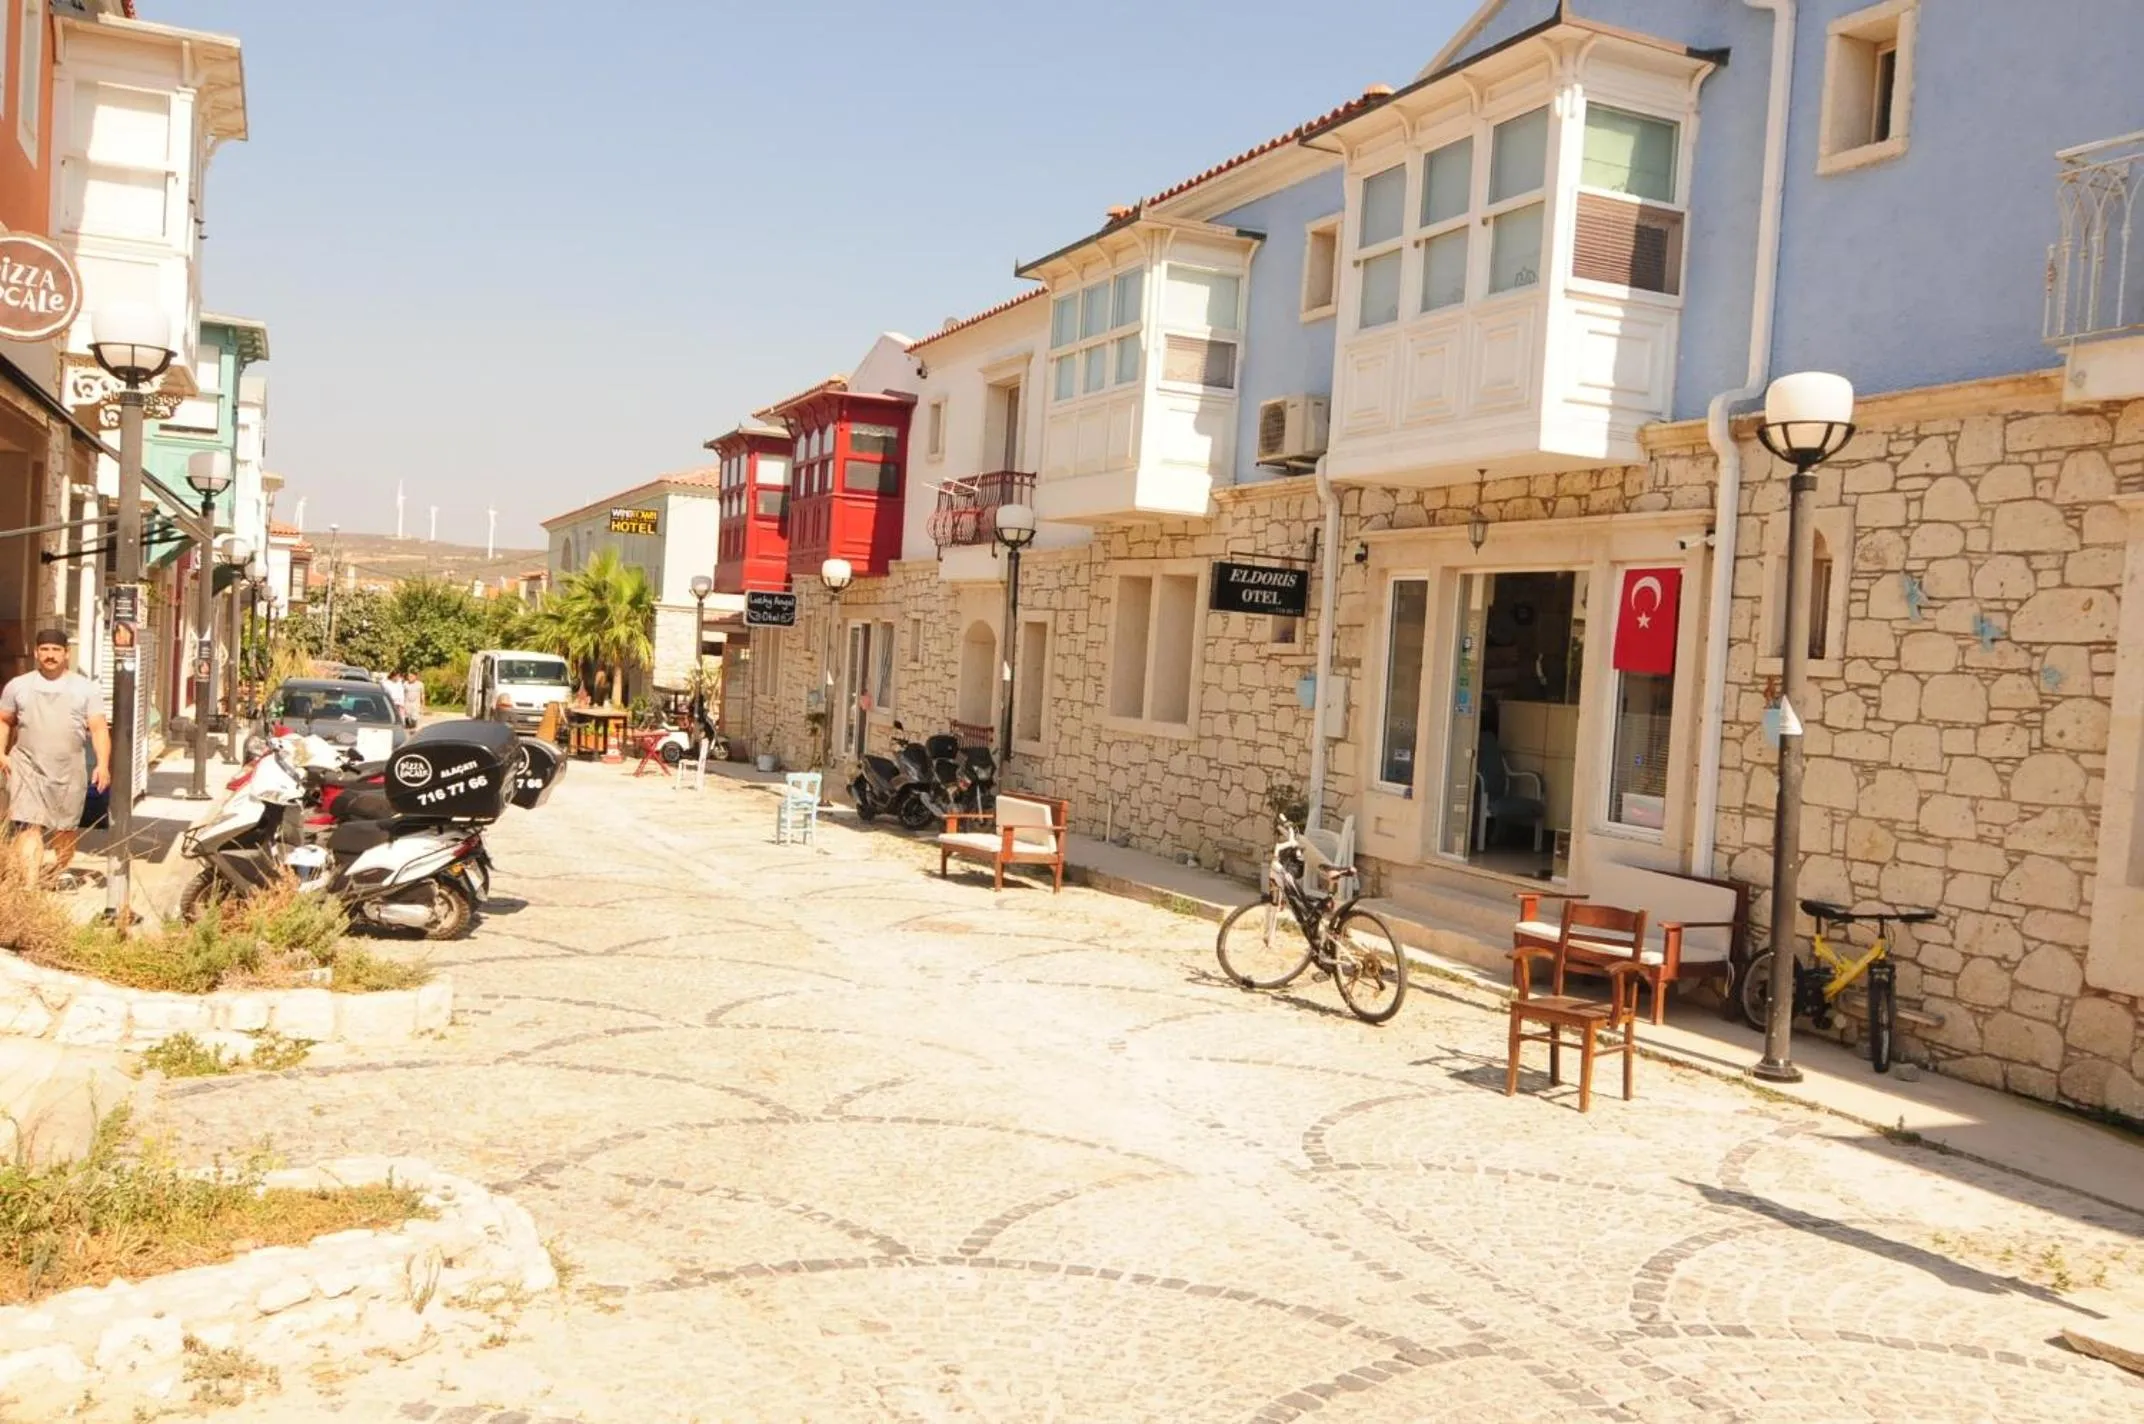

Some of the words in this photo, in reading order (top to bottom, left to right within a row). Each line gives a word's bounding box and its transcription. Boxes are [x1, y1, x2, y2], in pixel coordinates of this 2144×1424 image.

[611, 521, 655, 534] HOTEL
[1241, 587, 1281, 605] OTEL
[447, 778, 465, 797] 77
[468, 775, 488, 790] 66
